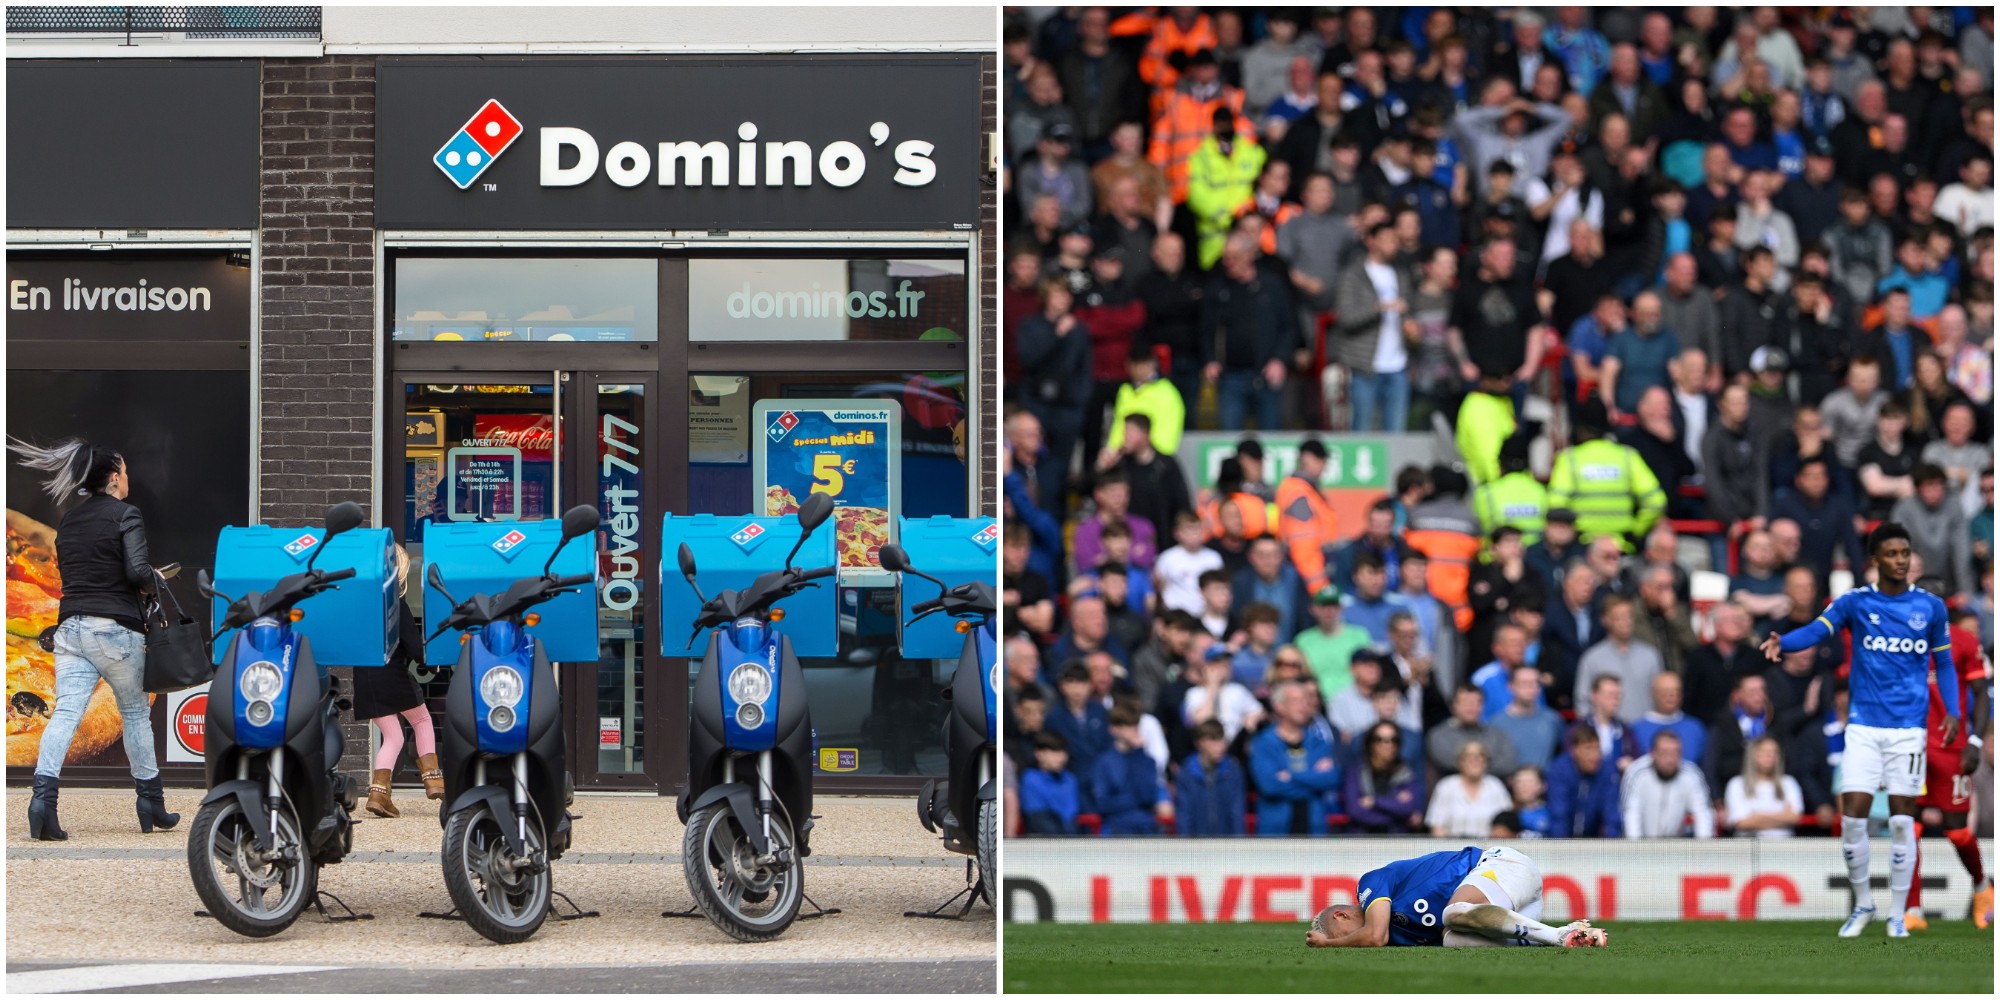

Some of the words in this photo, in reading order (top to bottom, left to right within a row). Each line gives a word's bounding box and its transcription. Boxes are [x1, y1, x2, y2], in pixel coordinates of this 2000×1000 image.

[540, 121, 937, 188] Domino's
[483, 184, 498, 192] TM
[10, 280, 51, 311] En
[64, 277, 211, 312] livraison
[726, 280, 926, 319] dominos.fr
[834, 411, 888, 420] dominos.fr
[462, 438, 492, 447] OUVERT
[602, 413, 640, 478] 7/7
[830, 430, 875, 446] midi
[602, 484, 640, 611] Ouvert
[1863, 634, 1928, 655] CAZOO
[188, 724, 199, 734] EN
[1908, 752, 1922, 775] 11
[1952, 774, 1972, 798] 10
